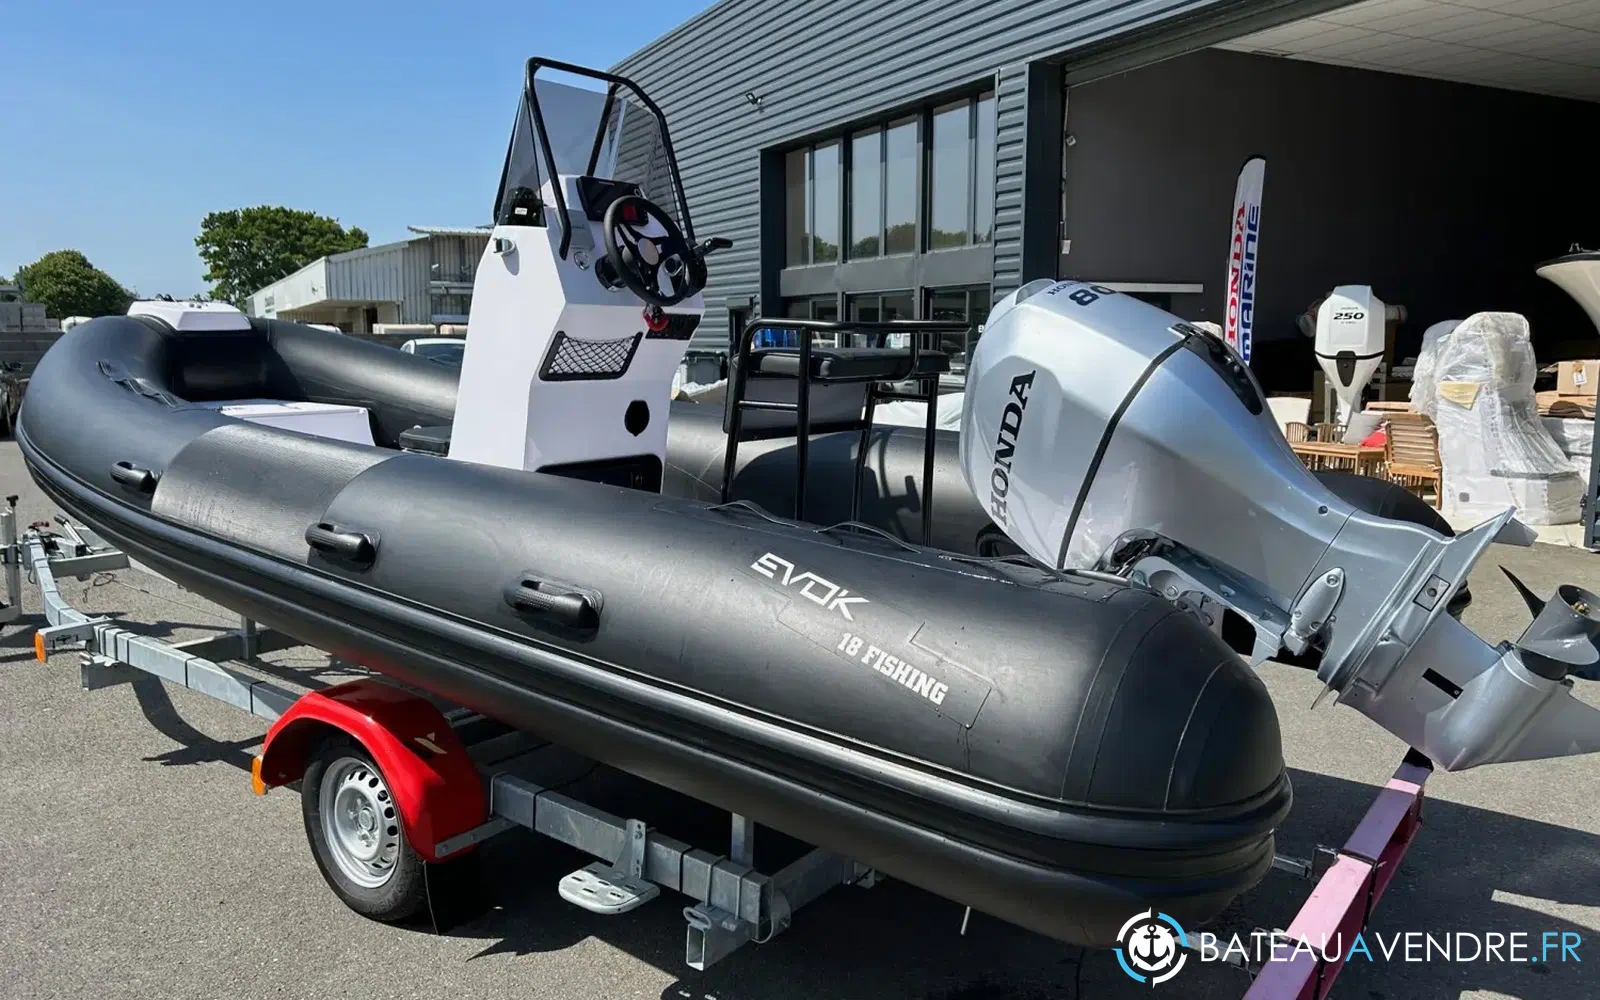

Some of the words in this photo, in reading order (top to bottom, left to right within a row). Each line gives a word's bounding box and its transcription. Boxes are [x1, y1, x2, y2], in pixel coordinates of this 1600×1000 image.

[1069, 285, 1117, 306] 80
[1333, 312, 1365, 320] 250
[991, 370, 1036, 526] HONDA
[751, 552, 870, 622] EVOK
[837, 632, 863, 657] 18
[861, 646, 949, 705] FISHING
